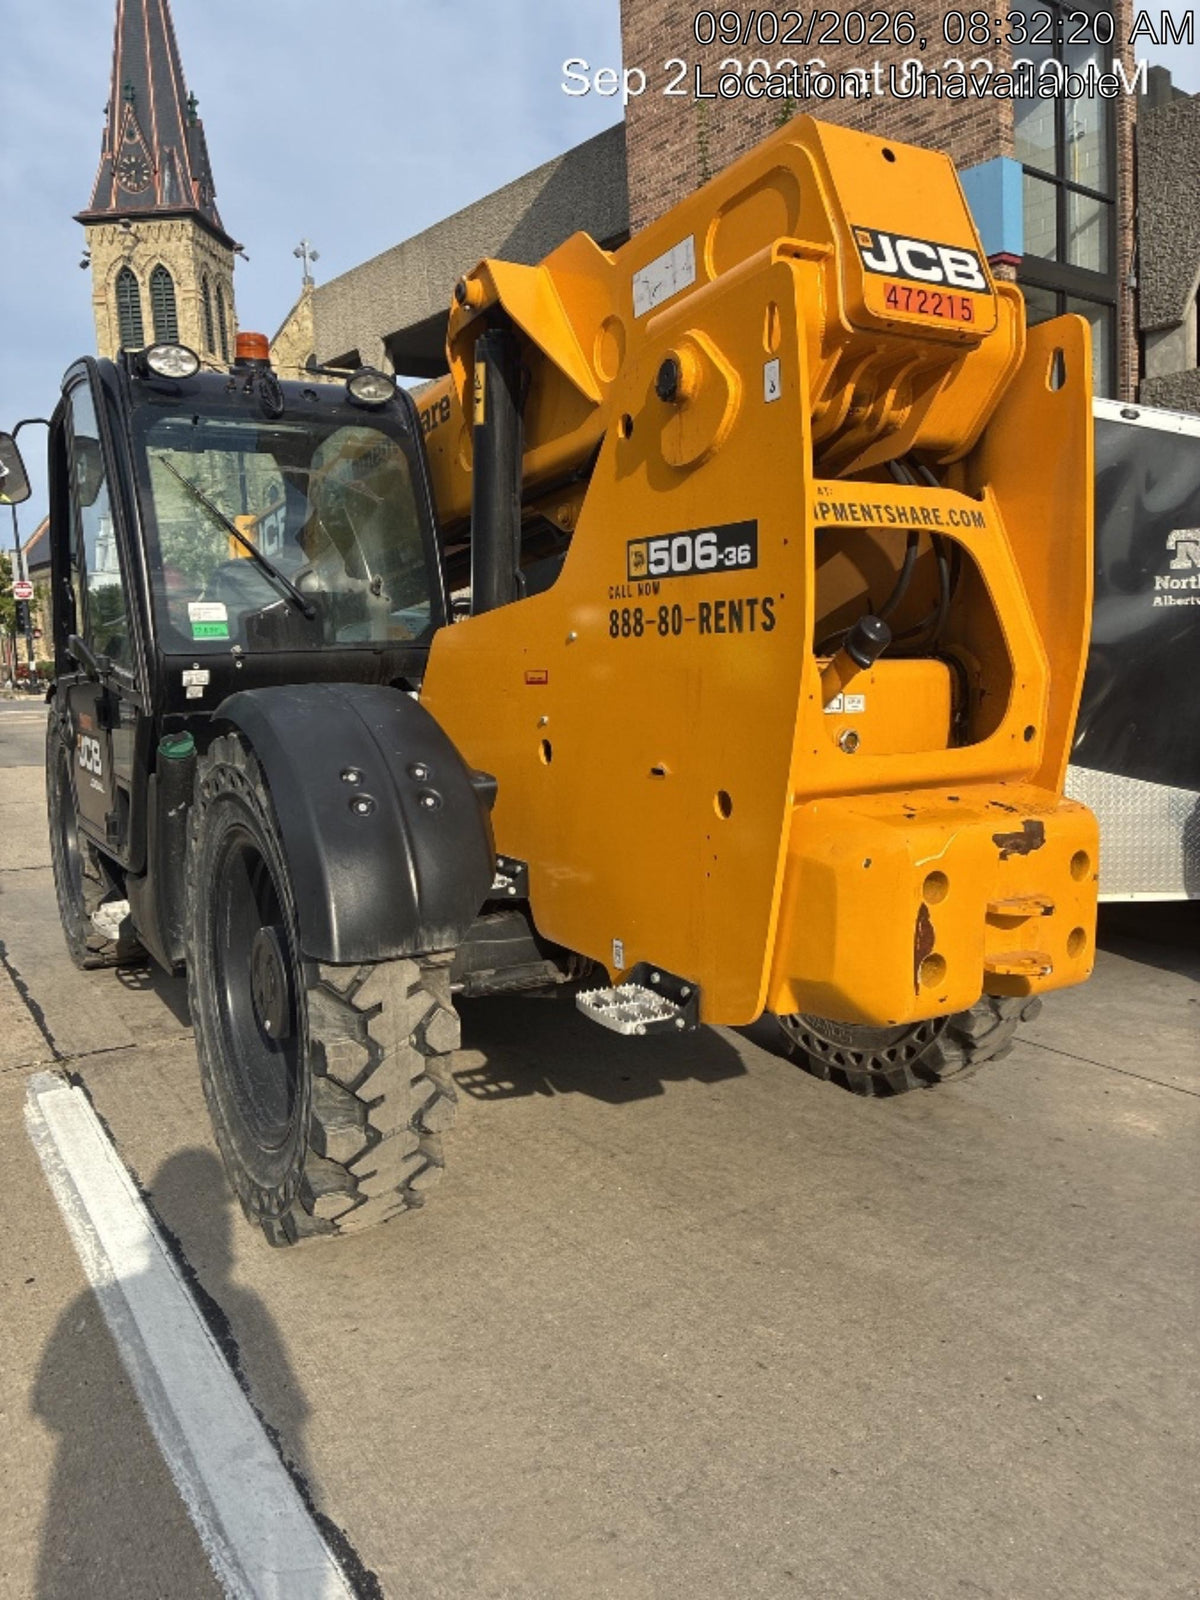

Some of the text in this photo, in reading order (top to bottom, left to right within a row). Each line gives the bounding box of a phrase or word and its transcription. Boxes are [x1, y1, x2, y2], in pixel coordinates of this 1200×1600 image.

[861, 233, 986, 290] JCB
[886, 285, 973, 321] 472215
[648, 531, 751, 575] 506-36
[608, 580, 661, 600] CALL NOW
[608, 596, 777, 639] 888-80-RENTS
